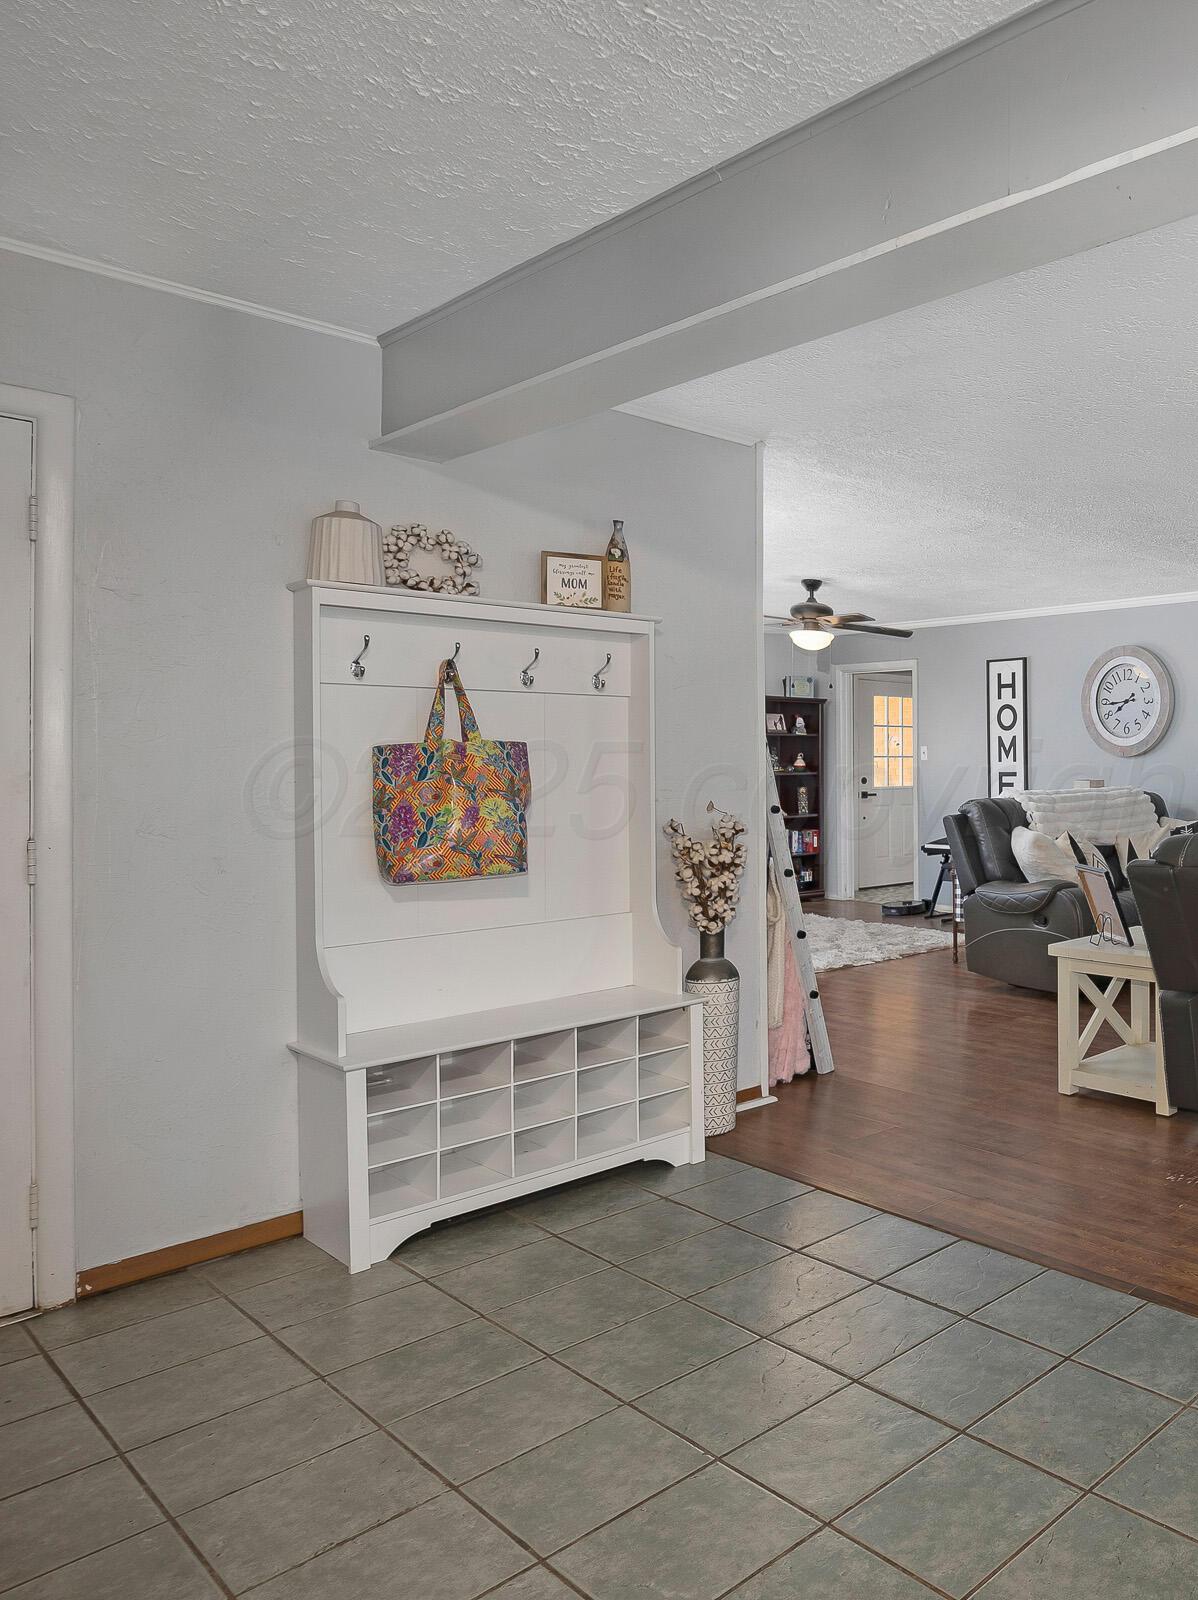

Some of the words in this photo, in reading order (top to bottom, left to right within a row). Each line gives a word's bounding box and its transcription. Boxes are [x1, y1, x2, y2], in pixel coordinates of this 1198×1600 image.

[561, 577, 588, 590] MOM
[1111, 671, 1122, 685] 11
[1123, 668, 1133, 681] 12
[1134, 673, 1141, 684] 1
[1103, 681, 1115, 694] 10
[1139, 681, 1151, 693] 2
[1143, 697, 1154, 705] 3
[1103, 710, 1114, 720] 8
[1141, 709, 1151, 720] 4
[1112, 718, 1121, 730] 7
[1123, 721, 1131, 735] 6
[1134, 718, 1142, 731] 5
